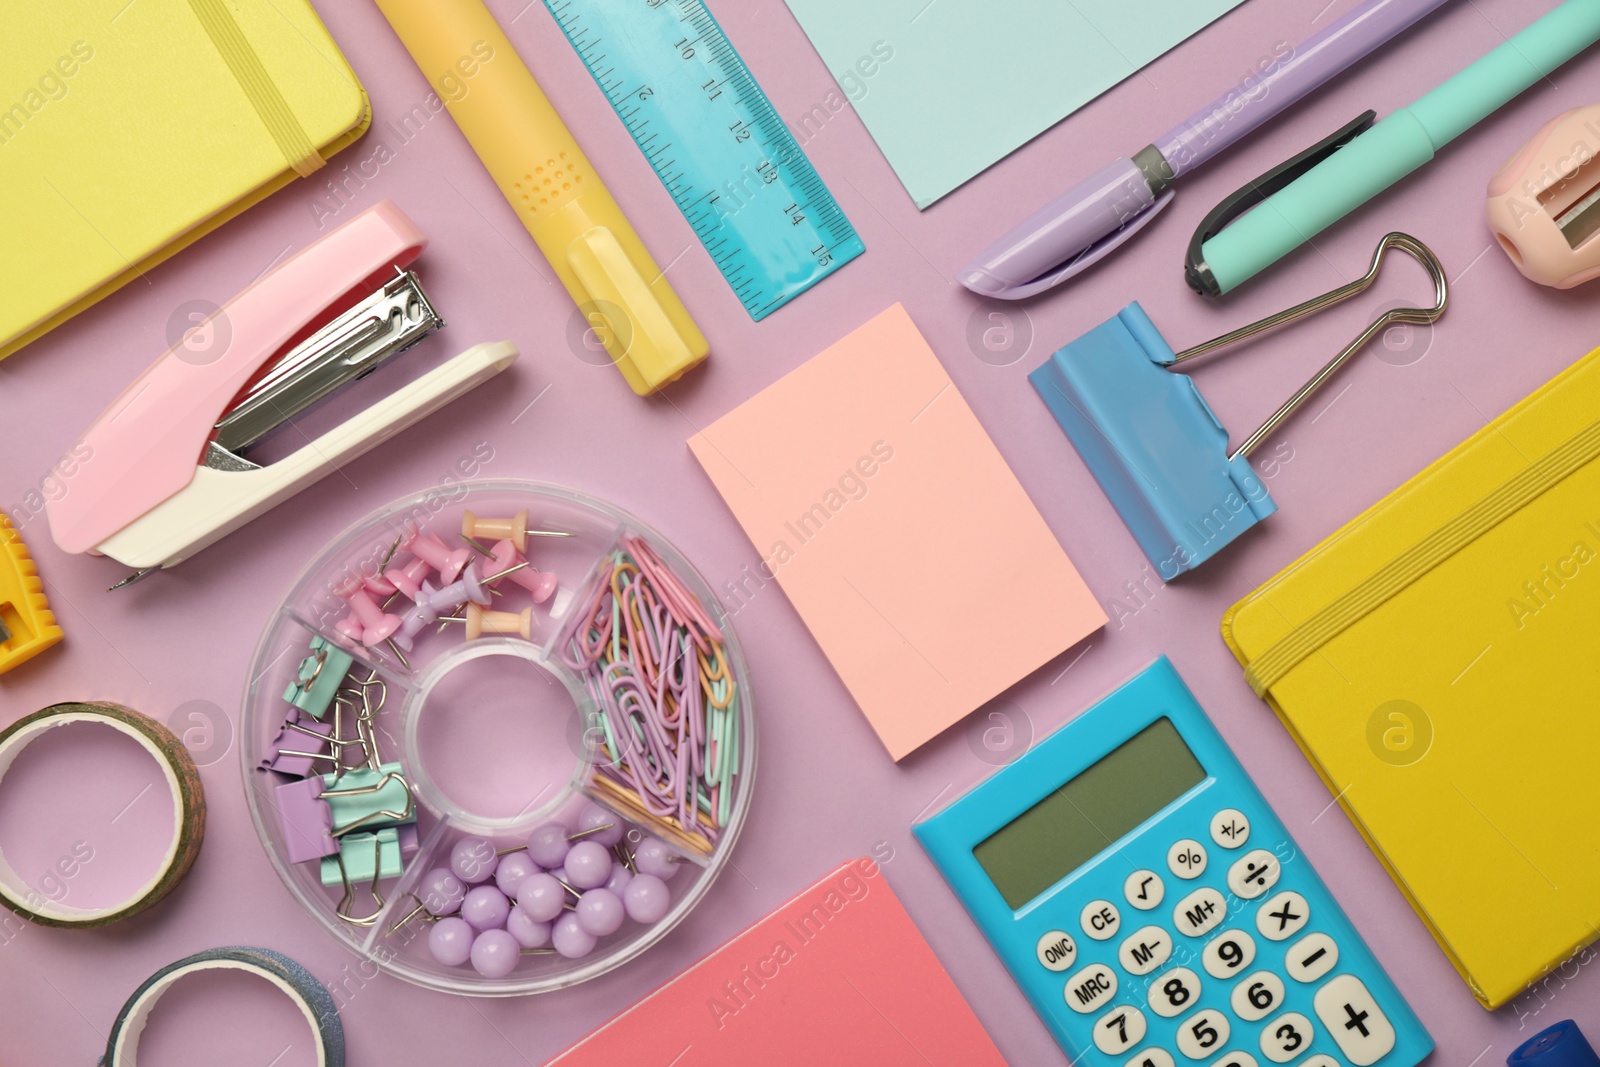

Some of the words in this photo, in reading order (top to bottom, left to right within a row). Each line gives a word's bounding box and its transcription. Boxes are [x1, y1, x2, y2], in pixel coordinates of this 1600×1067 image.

[638, 87, 655, 102] 2
[673, 37, 696, 60] 10
[701, 78, 723, 102] 11
[728, 119, 751, 144] 12
[756, 161, 778, 185] 13
[783, 202, 806, 226] 14
[810, 243, 834, 267] 15
[1091, 906, 1116, 931] CE
[1185, 899, 1216, 928] M+
[1044, 937, 1074, 965] ON/C
[1217, 940, 1244, 968] 9
[1073, 972, 1111, 1007] MRC
[1163, 978, 1190, 1007] 8
[1247, 982, 1273, 1010] 6
[1106, 1013, 1128, 1044] 7
[1191, 1018, 1218, 1048] 5
[1275, 1023, 1303, 1052] 3
